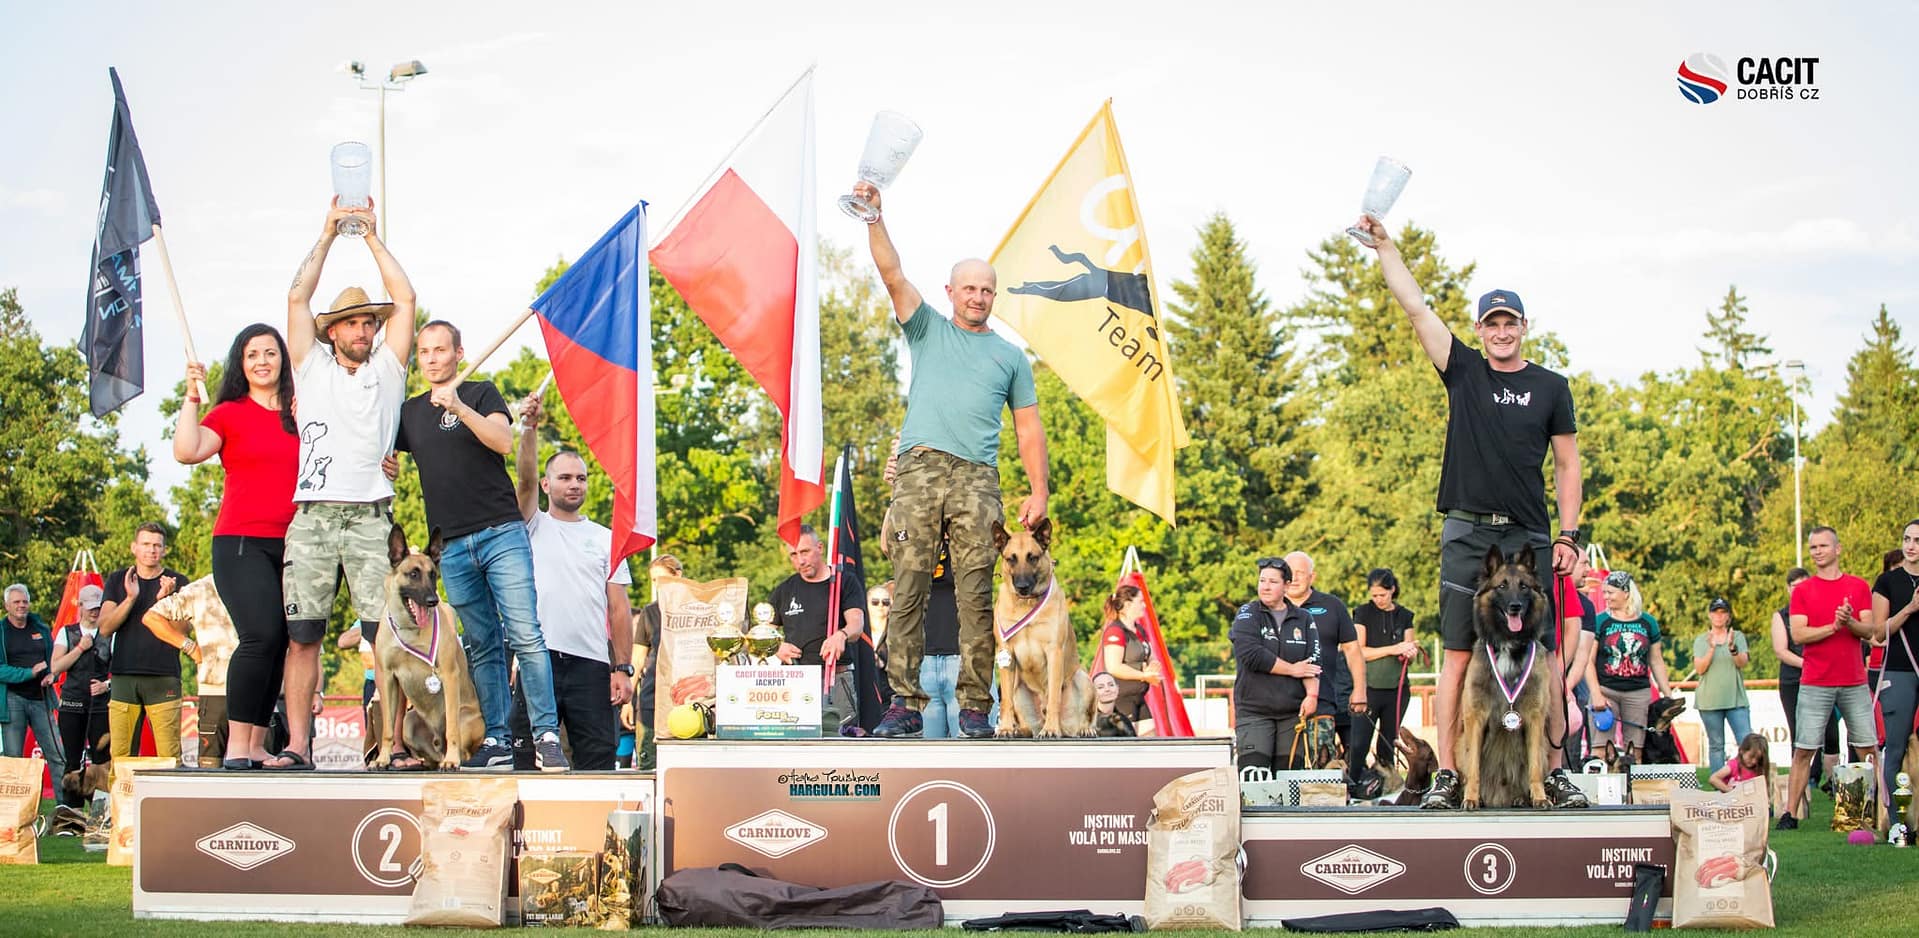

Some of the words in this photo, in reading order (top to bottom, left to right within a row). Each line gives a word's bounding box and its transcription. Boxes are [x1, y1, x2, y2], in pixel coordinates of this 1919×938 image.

[1098, 306, 1164, 382] Team
[665, 615, 693, 629] TRUE
[693, 614, 720, 628] FRES
[735, 670, 756, 679] CACIT
[786, 670, 805, 679] 2025
[755, 678, 786, 687] JACKPOT
[749, 691, 778, 702] 2000
[6, 784, 31, 795] FRESH
[119, 783, 134, 793] TRU
[1685, 807, 1714, 819] TRUE
[1717, 805, 1754, 820] FRESH
[1084, 814, 1135, 829] INSTINKT
[513, 829, 564, 843] INSTINKT
[738, 827, 811, 838] CARNILOVE
[927, 802, 948, 866] 1
[1069, 828, 1097, 845] VOLÁ
[1100, 831, 1115, 845] PO
[1118, 831, 1149, 845] MASU
[209, 840, 279, 851] CARNILOVE
[379, 823, 402, 872] 2
[1601, 847, 1653, 862] INSTINKT
[1315, 863, 1389, 874] CARNILOVE
[1482, 853, 1498, 884] 3
[1586, 862, 1615, 878] VOLÁ
[1617, 864, 1633, 878] PO
